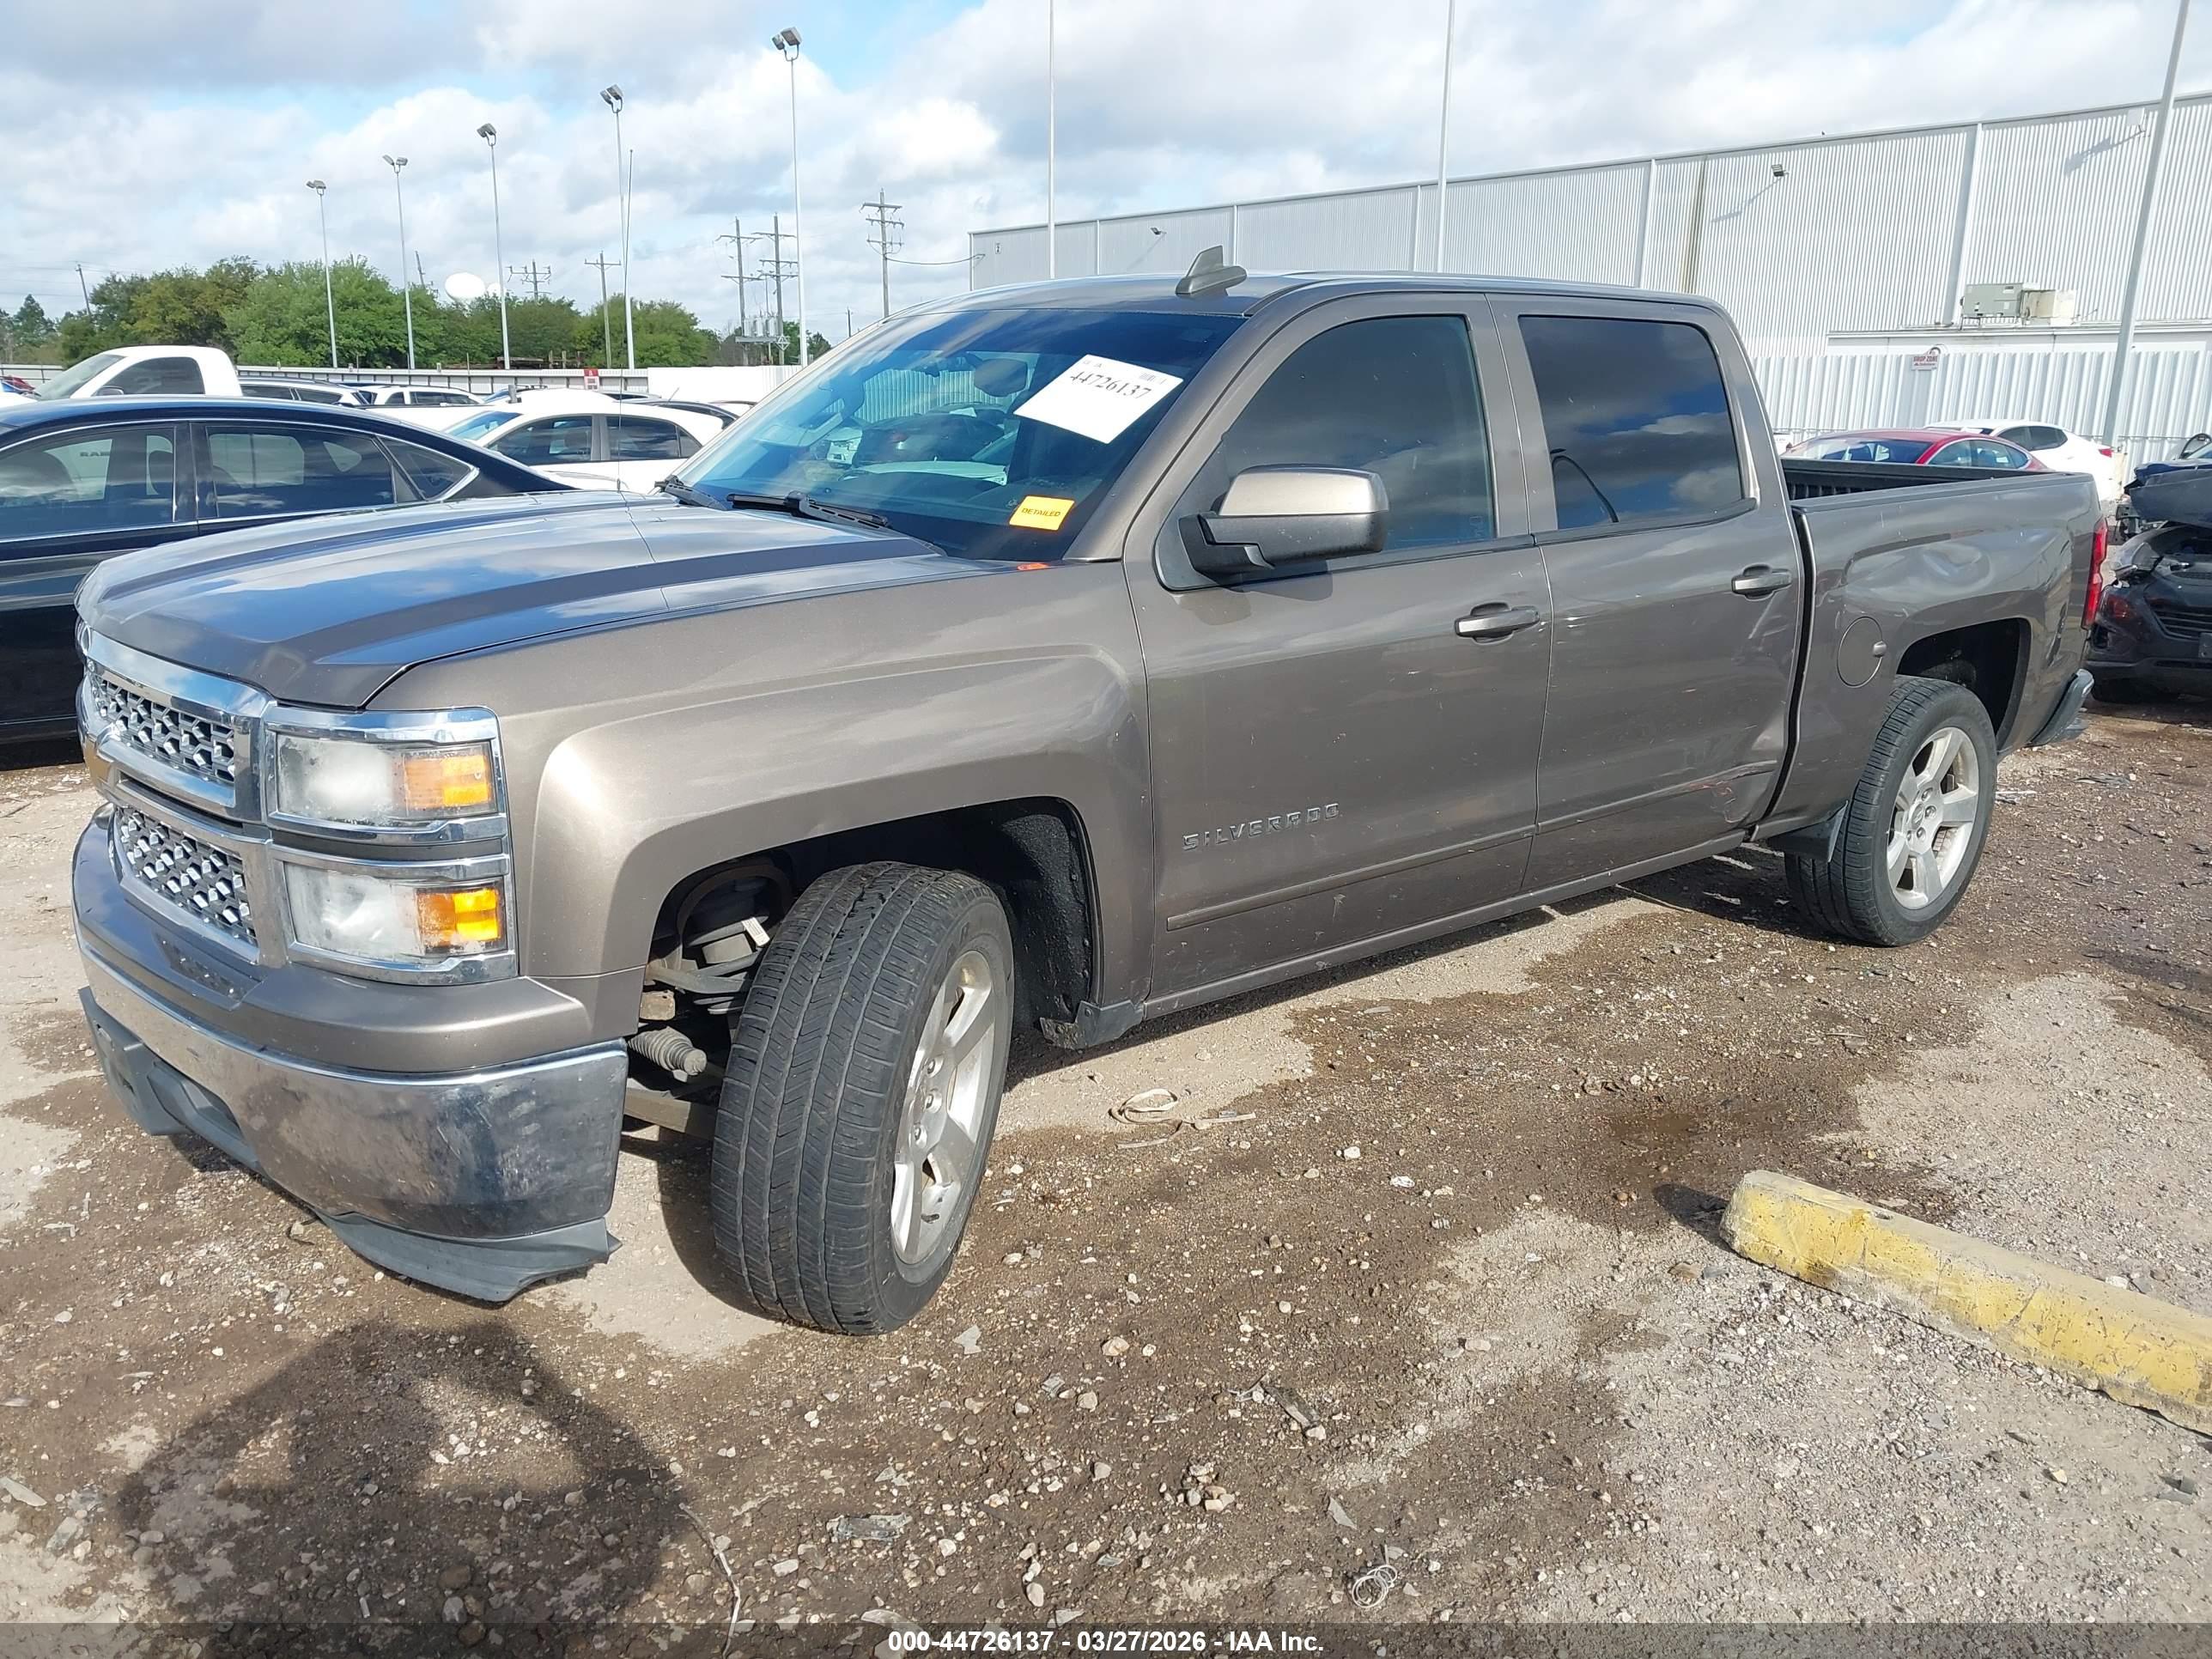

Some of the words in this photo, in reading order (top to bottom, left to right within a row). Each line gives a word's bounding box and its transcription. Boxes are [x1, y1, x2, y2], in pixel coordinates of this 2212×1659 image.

[1070, 371, 1152, 398] 44726137
[1022, 507, 1060, 516] DETAILED
[1182, 803, 1340, 851] SILVERADO
